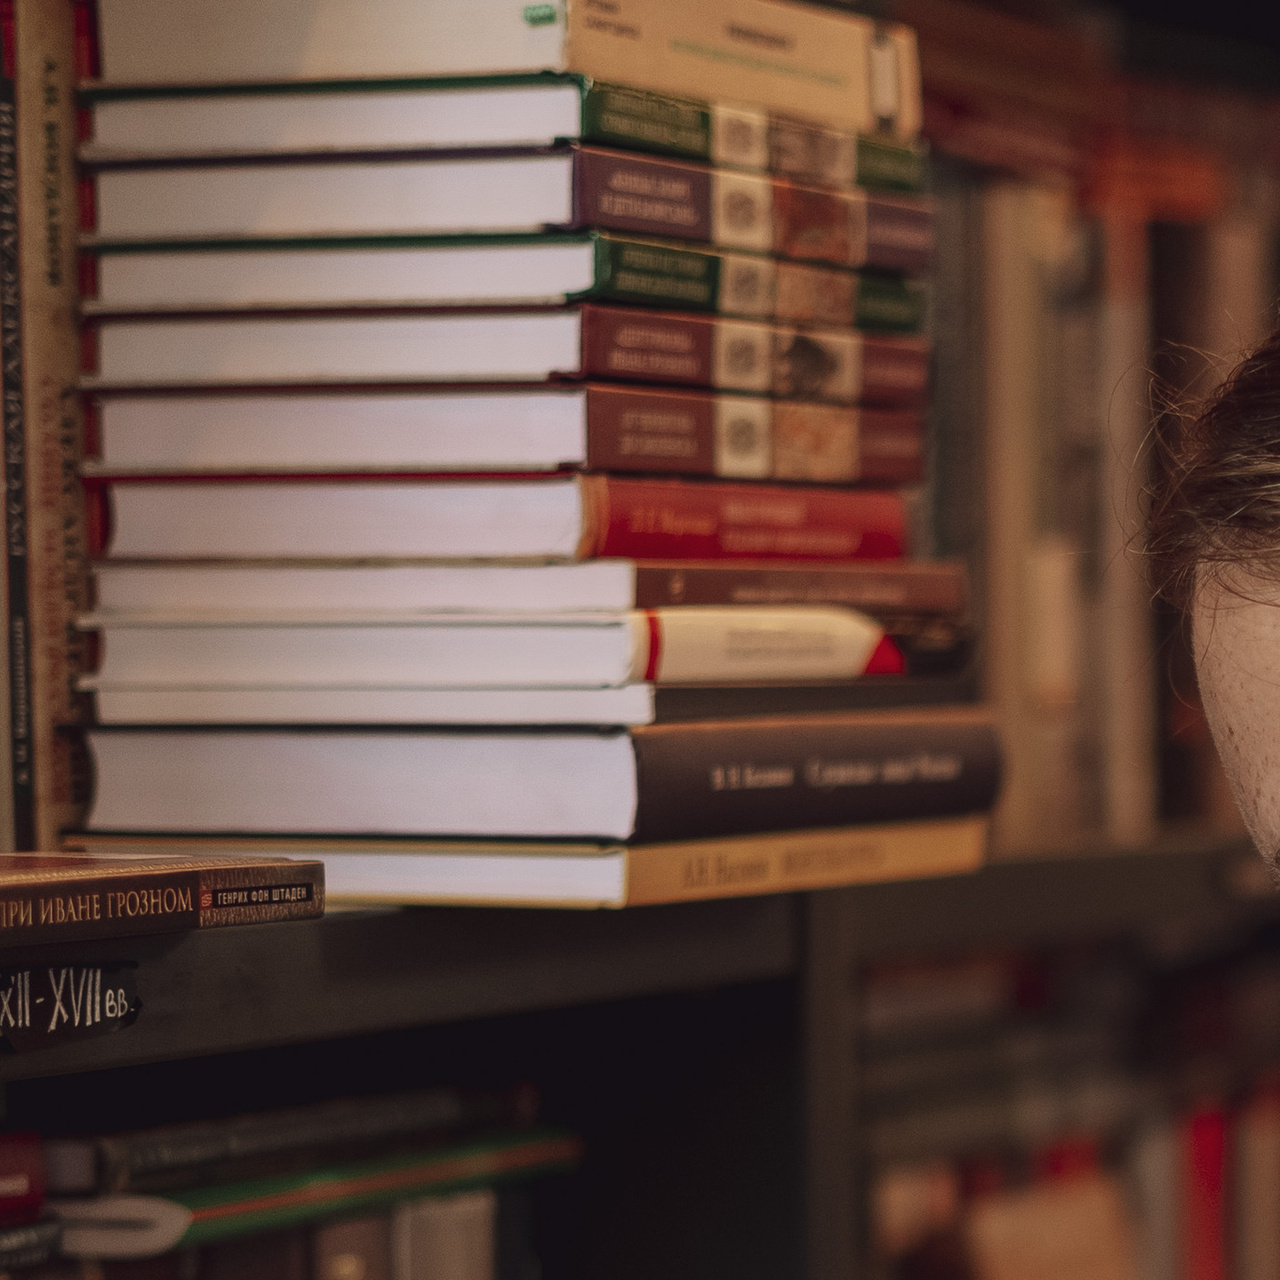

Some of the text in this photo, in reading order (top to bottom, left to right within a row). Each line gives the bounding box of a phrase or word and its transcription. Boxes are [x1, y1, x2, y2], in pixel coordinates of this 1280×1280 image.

[40, 894, 101, 925] ИВАНЕ
[107, 887, 193, 918] ГРОЗНОМ
[217, 886, 307, 905] ГЕНРИХ ФОН ШТАДЕН
